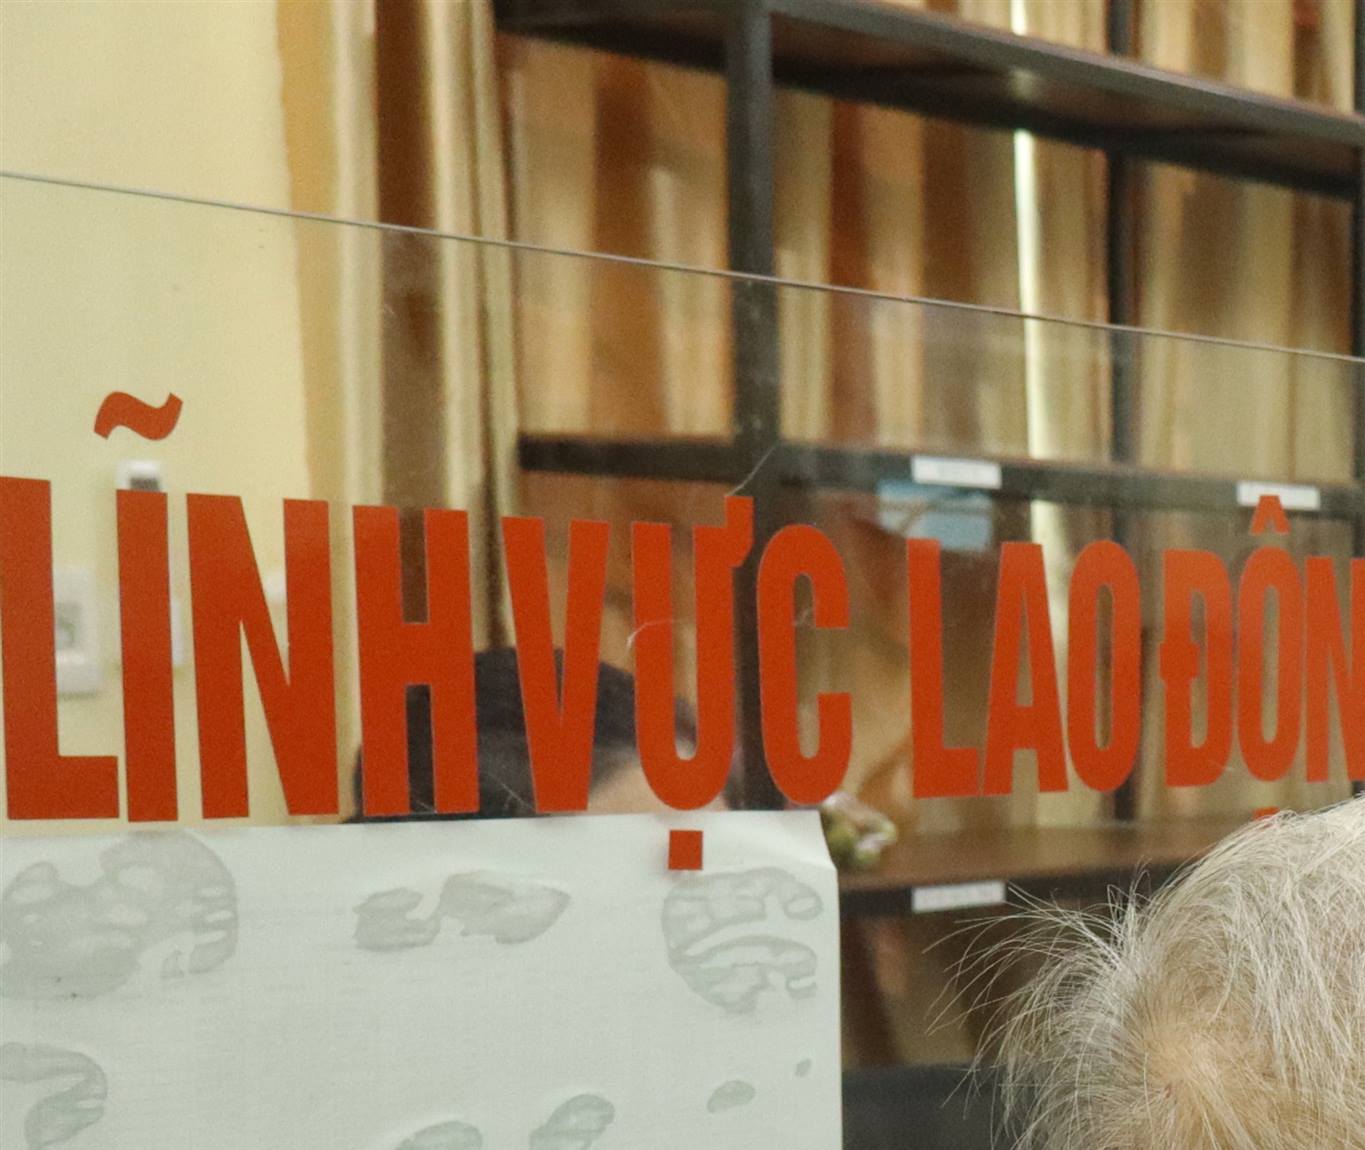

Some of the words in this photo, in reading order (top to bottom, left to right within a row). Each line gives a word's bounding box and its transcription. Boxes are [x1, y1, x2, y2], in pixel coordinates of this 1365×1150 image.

[0, 391, 480, 822] LĨNH
[502, 496, 853, 870] VỰC
[907, 538, 1142, 799] LAO
